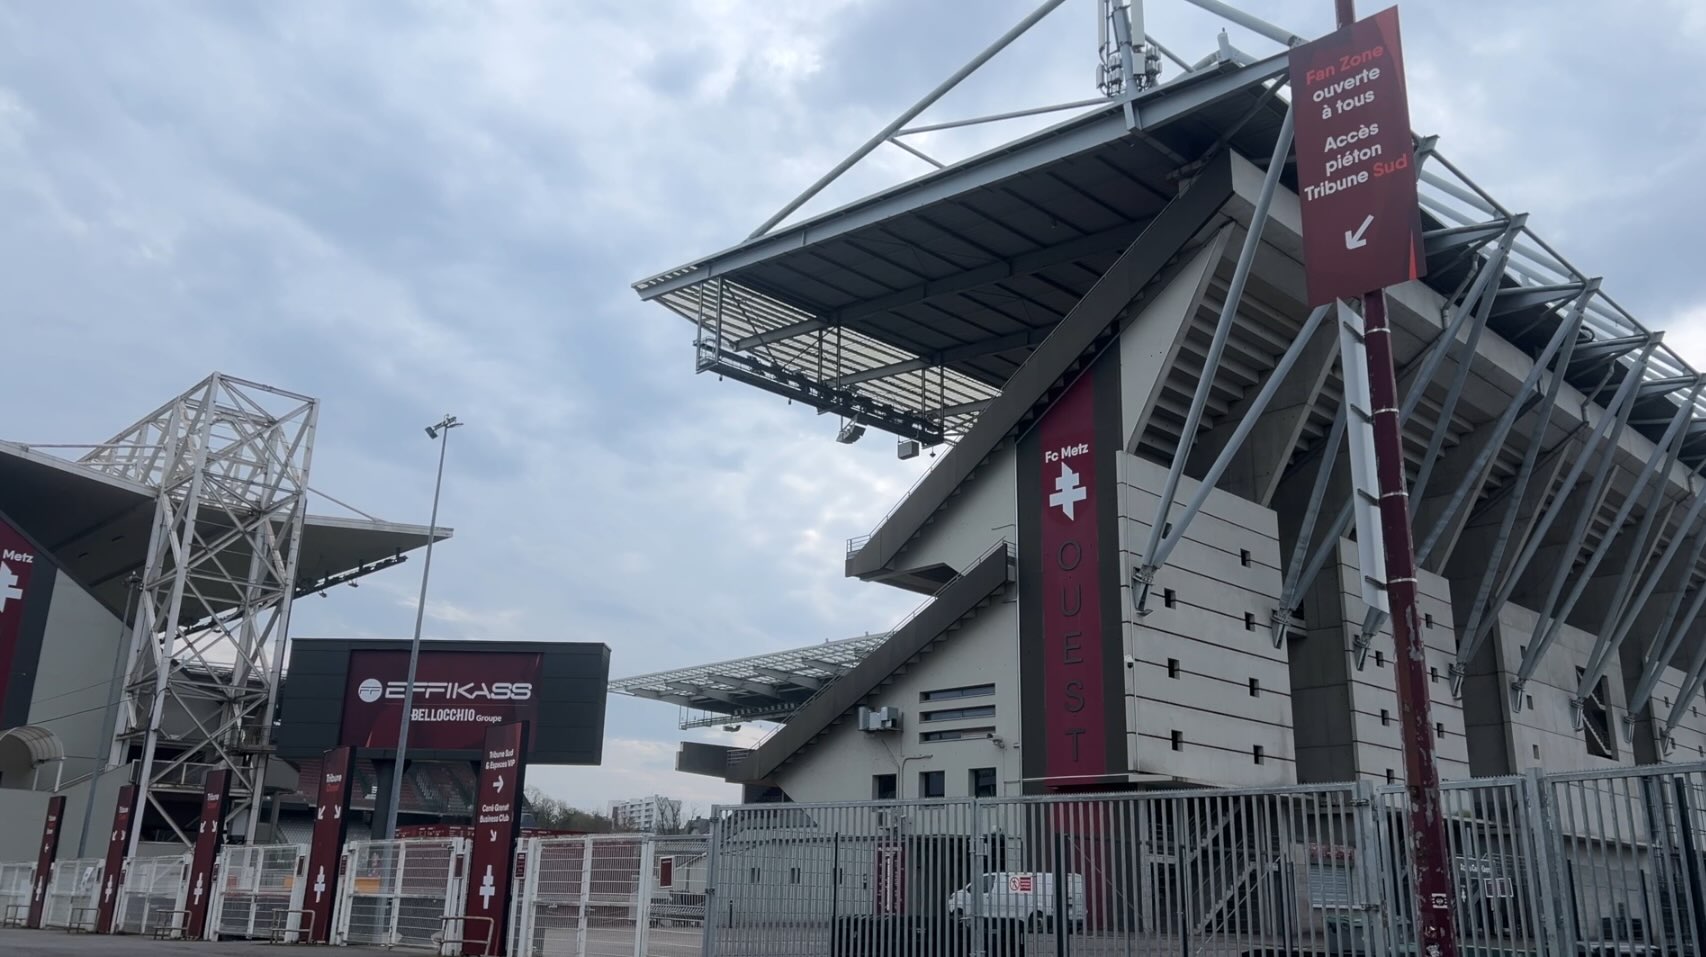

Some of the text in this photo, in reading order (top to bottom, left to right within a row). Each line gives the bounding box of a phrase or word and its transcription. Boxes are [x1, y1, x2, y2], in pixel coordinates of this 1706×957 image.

[1305, 46, 1384, 85] Fan Zone
[1312, 67, 1381, 102] ouverte
[1321, 90, 1375, 120] à tous
[1323, 123, 1379, 153] Accès
[1325, 143, 1382, 177] piéton
[1303, 153, 1409, 201] Tribune Sud
[1045, 443, 1089, 463] Fc Metz
[2, 549, 34, 563] Metz
[1056, 539, 1086, 763] OUEST
[385, 681, 533, 700] EFFIKASS
[411, 708, 502, 724] BELLOCCHIO Groupe
[489, 749, 514, 759] Tribune Sud
[499, 814, 509, 822] Club
